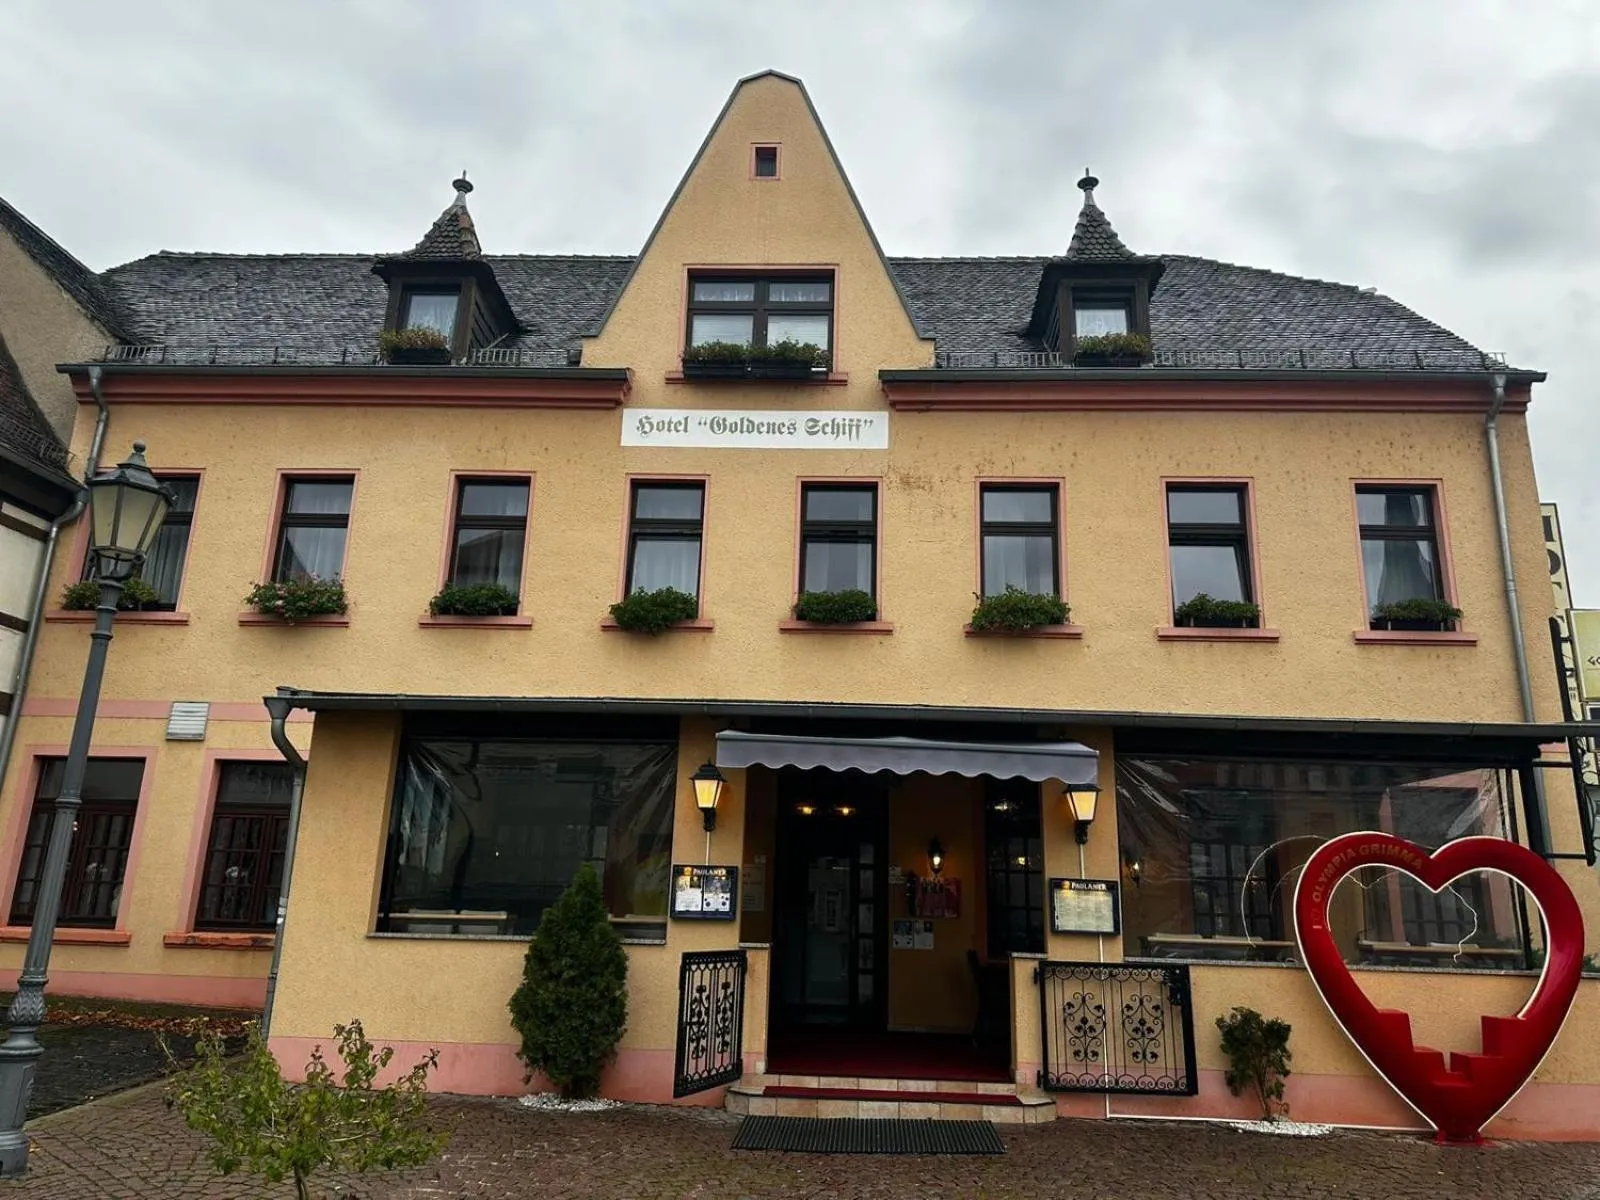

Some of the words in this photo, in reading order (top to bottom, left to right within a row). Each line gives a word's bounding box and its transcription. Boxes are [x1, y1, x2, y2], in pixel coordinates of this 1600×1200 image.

[636, 415, 689, 438] Hotel
[1312, 848, 1356, 902] OLYMPIA
[1359, 843, 1423, 869] GRIMMA
[1071, 881, 1107, 890] PAULANER
